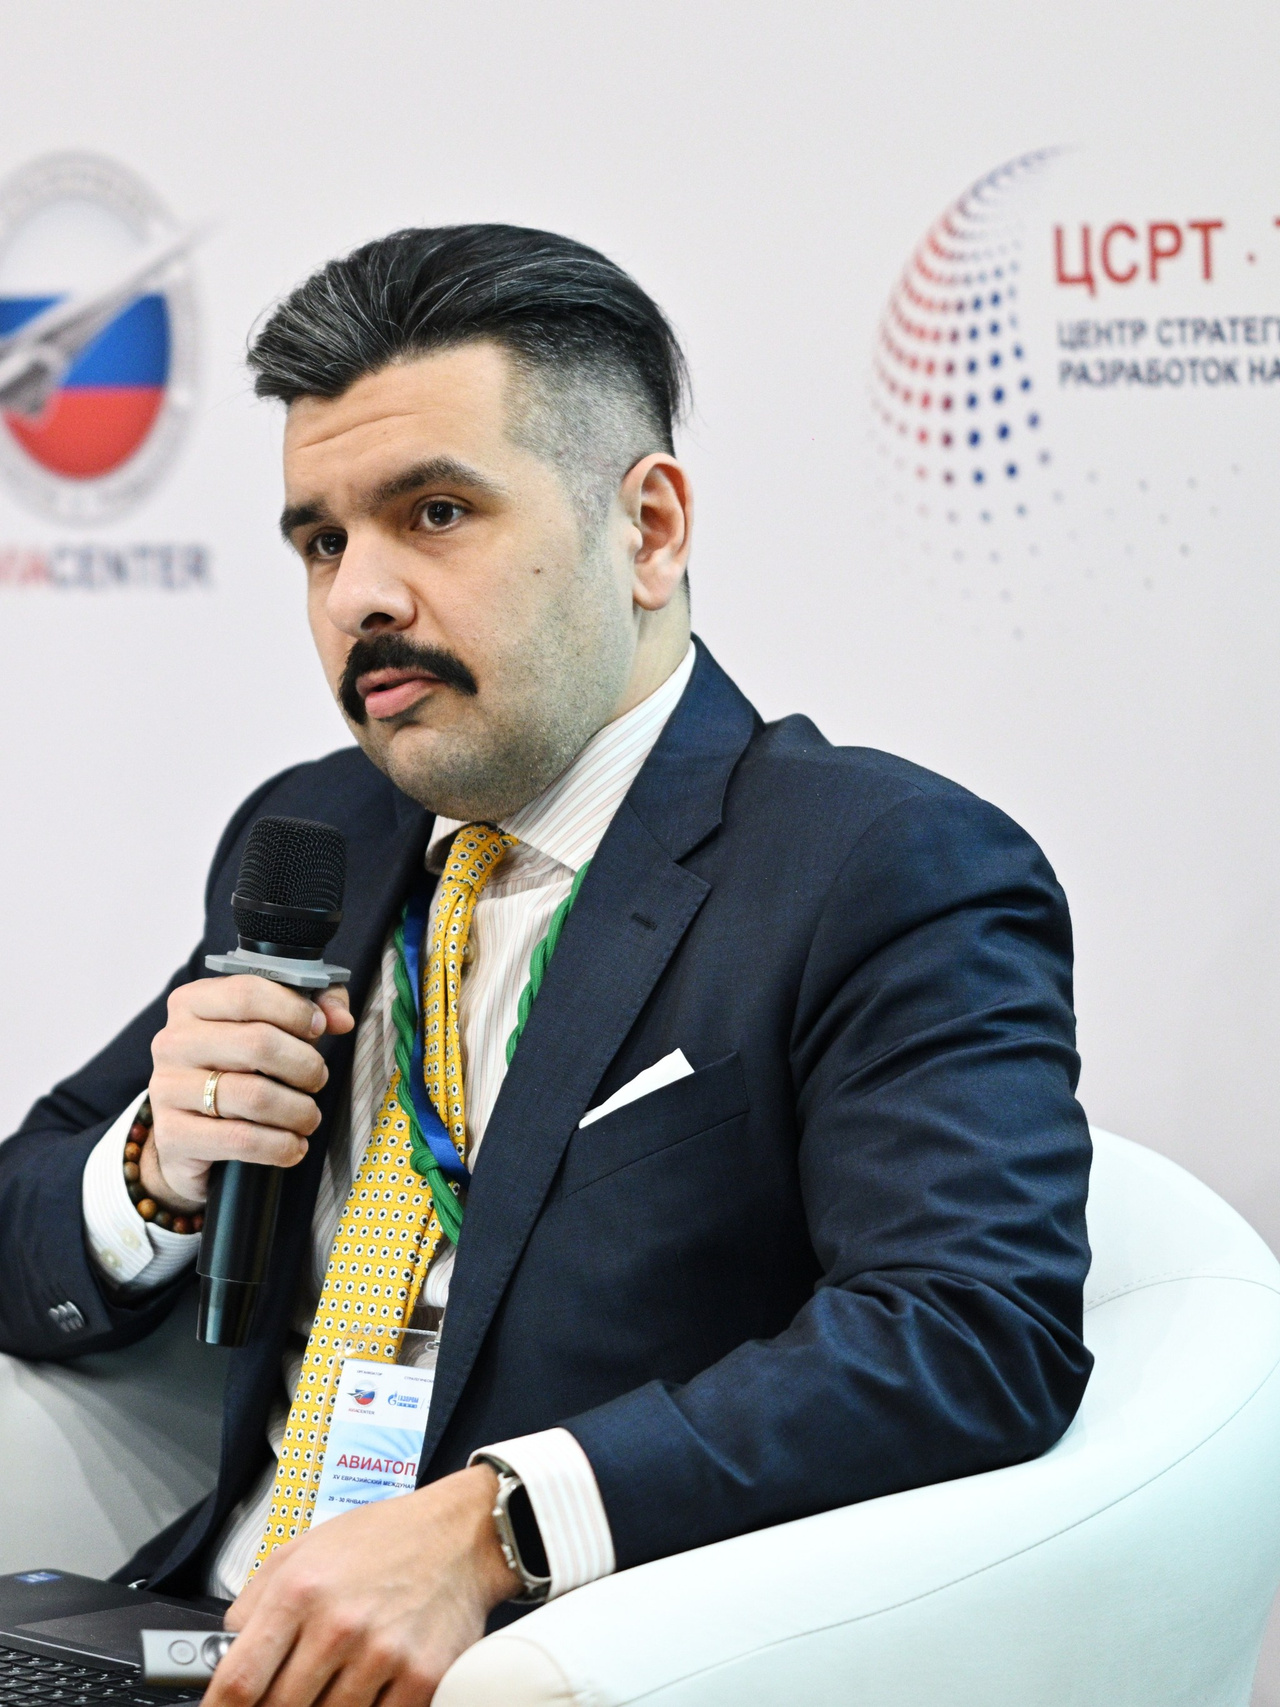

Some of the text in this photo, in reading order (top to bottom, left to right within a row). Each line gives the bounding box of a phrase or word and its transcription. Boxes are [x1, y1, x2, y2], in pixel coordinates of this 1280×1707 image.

[1055, 216, 1225, 298] ЦСРТ
[1057, 315, 1280, 350] ЦЕНТР СТРАТЕГ
[1058, 355, 1238, 387] РАЗРАБОТОК
[248, 966, 280, 980] MIC
[336, 1454, 417, 1477] АВИАТОП
[341, 1475, 382, 1486] ЕВРАЗИЙСКИЙ
